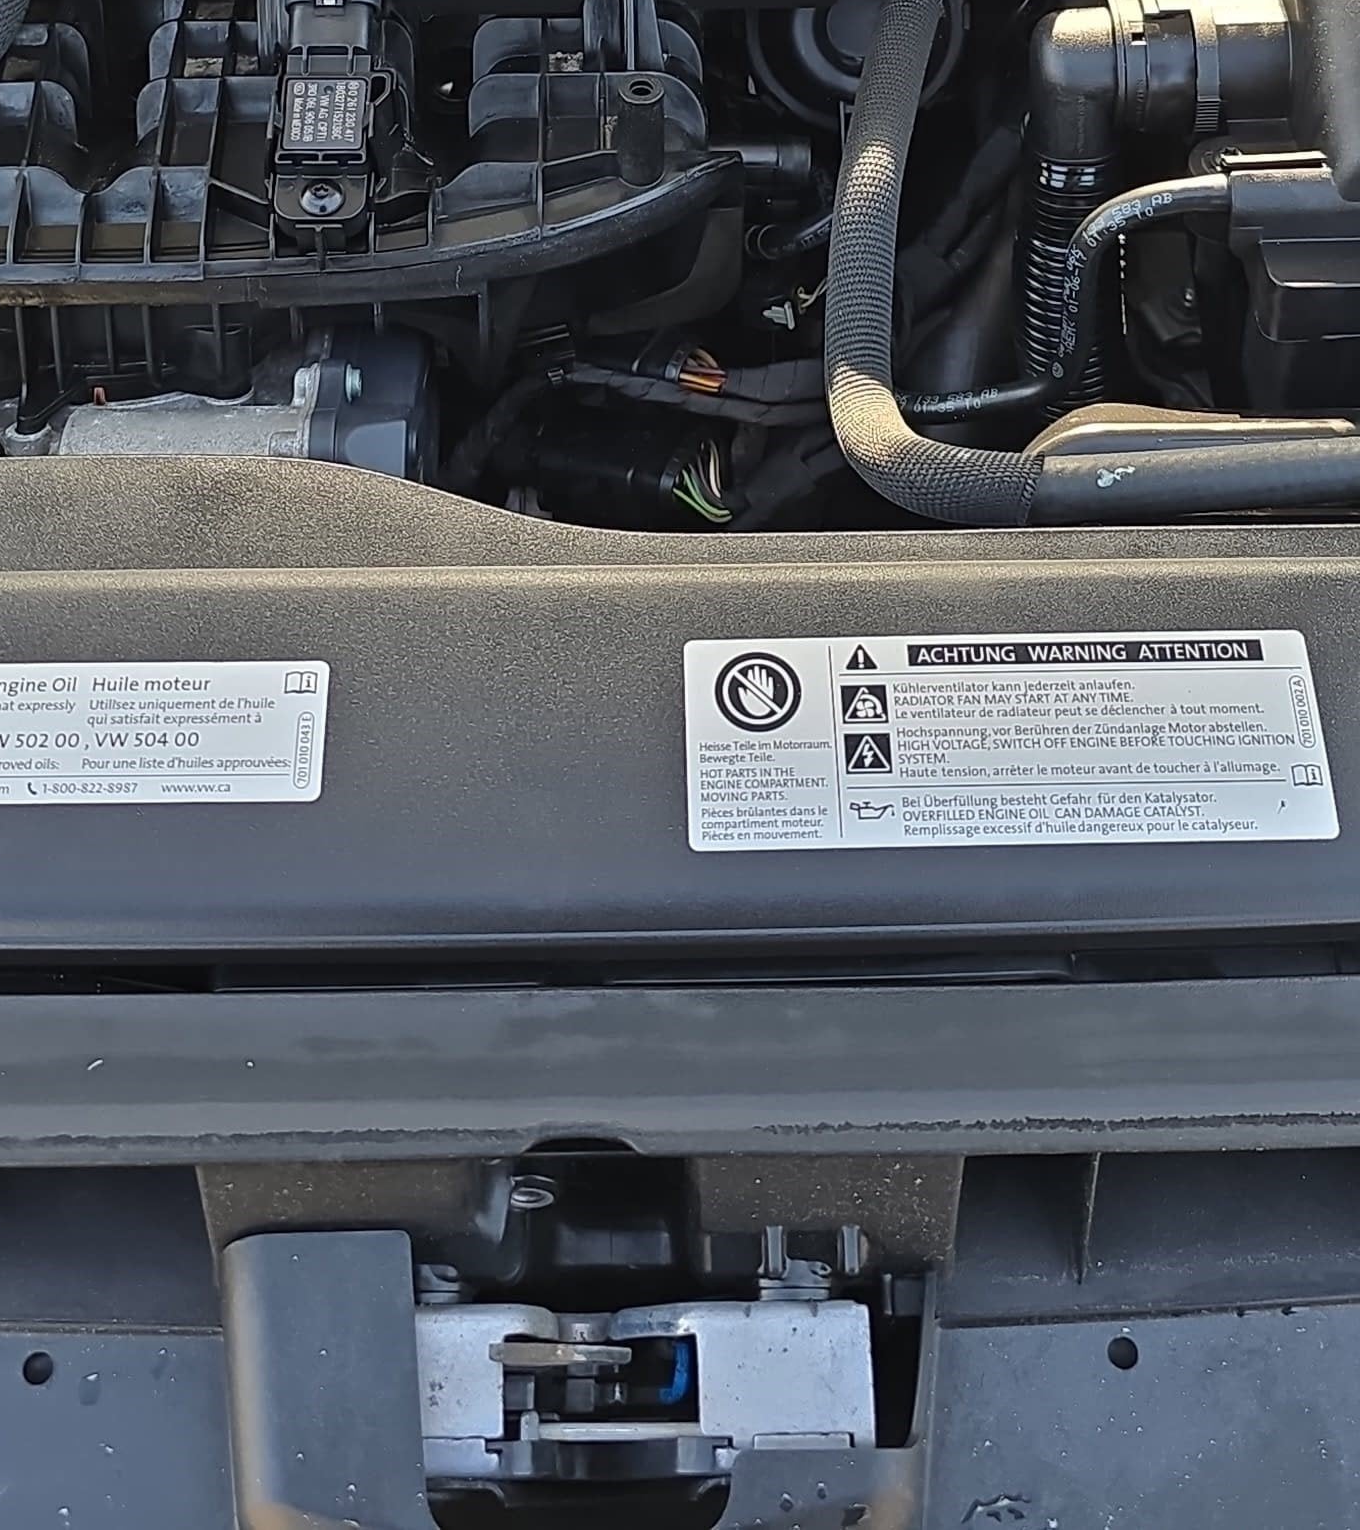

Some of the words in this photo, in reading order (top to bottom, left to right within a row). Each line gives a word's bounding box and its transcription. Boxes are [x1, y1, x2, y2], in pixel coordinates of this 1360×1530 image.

[1112, 199, 1141, 217] 583
[1151, 192, 1173, 206] AB
[915, 645, 1016, 664] ACHTUNG
[1027, 643, 1128, 661] WARNING
[1136, 640, 1249, 659] ATTENTION
[51, 676, 78, 692] Oil
[91, 676, 140, 691] Huile
[143, 675, 211, 691] moteur
[892, 681, 989, 693] Kühlerventilator
[991, 680, 1021, 691] kann
[1077, 678, 1135, 690] anlaufen.
[16, 699, 76, 713] expressly
[88, 698, 136, 710] Utilisez
[137, 697, 216, 712] uniquement
[217, 697, 234, 709] de
[236, 697, 275, 709] l'huile
[893, 695, 954, 706] RADIATOR
[956, 694, 981, 705] FAN
[983, 694, 1012, 705] MAY
[1014, 693, 1051, 704] START
[1052, 692, 1070, 703] AT
[1071, 692, 1098, 703] ANY
[1098, 691, 1134, 702] TIME.
[894, 708, 908, 719] Le
[909, 707, 976, 719] ventilateur
[977, 706, 994, 718] de
[995, 705, 1052, 717] radiateur
[1053, 705, 1082, 719] peut
[1083, 707, 1098, 716] se
[1099, 703, 1166, 715] déclencher
[1168, 703, 1178, 714] à
[1179, 702, 1207, 714] tout
[1207, 701, 1264, 713] moment.
[86, 713, 108, 727] qui
[109, 713, 161, 724] satisfait
[162, 712, 251, 726] expressément
[253, 712, 263, 723] à
[895, 725, 991, 741] Hochspannung,
[992, 727, 1011, 736] vor
[1014, 724, 1070, 736] Berühren
[1071, 723, 1092, 735] der
[1093, 722, 1167, 737] Zündanlage
[1167, 721, 1207, 733] Motor
[1207, 720, 1267, 732] abstellen.
[13, 733, 50, 748] 502
[53, 732, 81, 747] 00
[93, 732, 129, 747] VW
[134, 731, 170, 746] 504
[173, 731, 200, 746] 00
[698, 741, 731, 751] Heisse
[732, 740, 757, 751] Teile
[757, 740, 771, 750] im
[772, 739, 832, 750] Motorraum.
[896, 739, 930, 751] HIGH
[932, 738, 991, 752] VOLTAGE,
[992, 737, 1041, 749] SWITCH
[1042, 737, 1068, 748] OFF
[1069, 736, 1117, 748] ENGINE
[1119, 735, 1166, 747] BEFORE
[1167, 734, 1235, 746] TOUCHING
[1237, 732, 1296, 745] IGNITION
[80, 757, 111, 770] Pour
[111, 760, 136, 770] une
[137, 756, 165, 769] liste
[166, 756, 214, 769] d'huiles
[698, 752, 746, 765] Bewegte
[747, 752, 775, 762] Teile.
[897, 752, 950, 764] SYSTEM.
[699, 768, 724, 778] HOT
[725, 767, 757, 778] PARTS
[759, 767, 772, 777] IN
[773, 766, 796, 777] THE
[898, 766, 938, 778] Haute
[940, 765, 990, 779] tension,
[991, 764, 1034, 776] arrêter
[1036, 764, 1048, 776] le
[1049, 763, 1096, 775] moteur
[1097, 762, 1133, 774] avant
[1134, 762, 1151, 774] de
[1153, 761, 1201, 773] toucher
[1201, 761, 1211, 772] à
[1212, 759, 1281, 775] l'allumage.
[160, 784, 231, 792] www.vw.ca
[699, 779, 742, 790] ENGINE
[743, 777, 829, 789] COMPARTMENT.
[700, 791, 748, 802] MOVING
[750, 790, 789, 801] PARTS.
[901, 795, 921, 808] Bei
[923, 794, 999, 811] Überfüllung
[999, 793, 1047, 806] besteht
[1049, 792, 1092, 805] Gefahr
[1096, 791, 1117, 804] für
[1117, 791, 1142, 804] den
[1143, 789, 1217, 806] Katalysator.
[902, 809, 976, 822] OVERFILLED
[977, 808, 1026, 820] ENGINE
[1027, 807, 1049, 819] OIL
[1053, 807, 1082, 819] CAN
[1083, 805, 1141, 818] DAMAGE
[1142, 804, 1205, 817] CATALYST.
